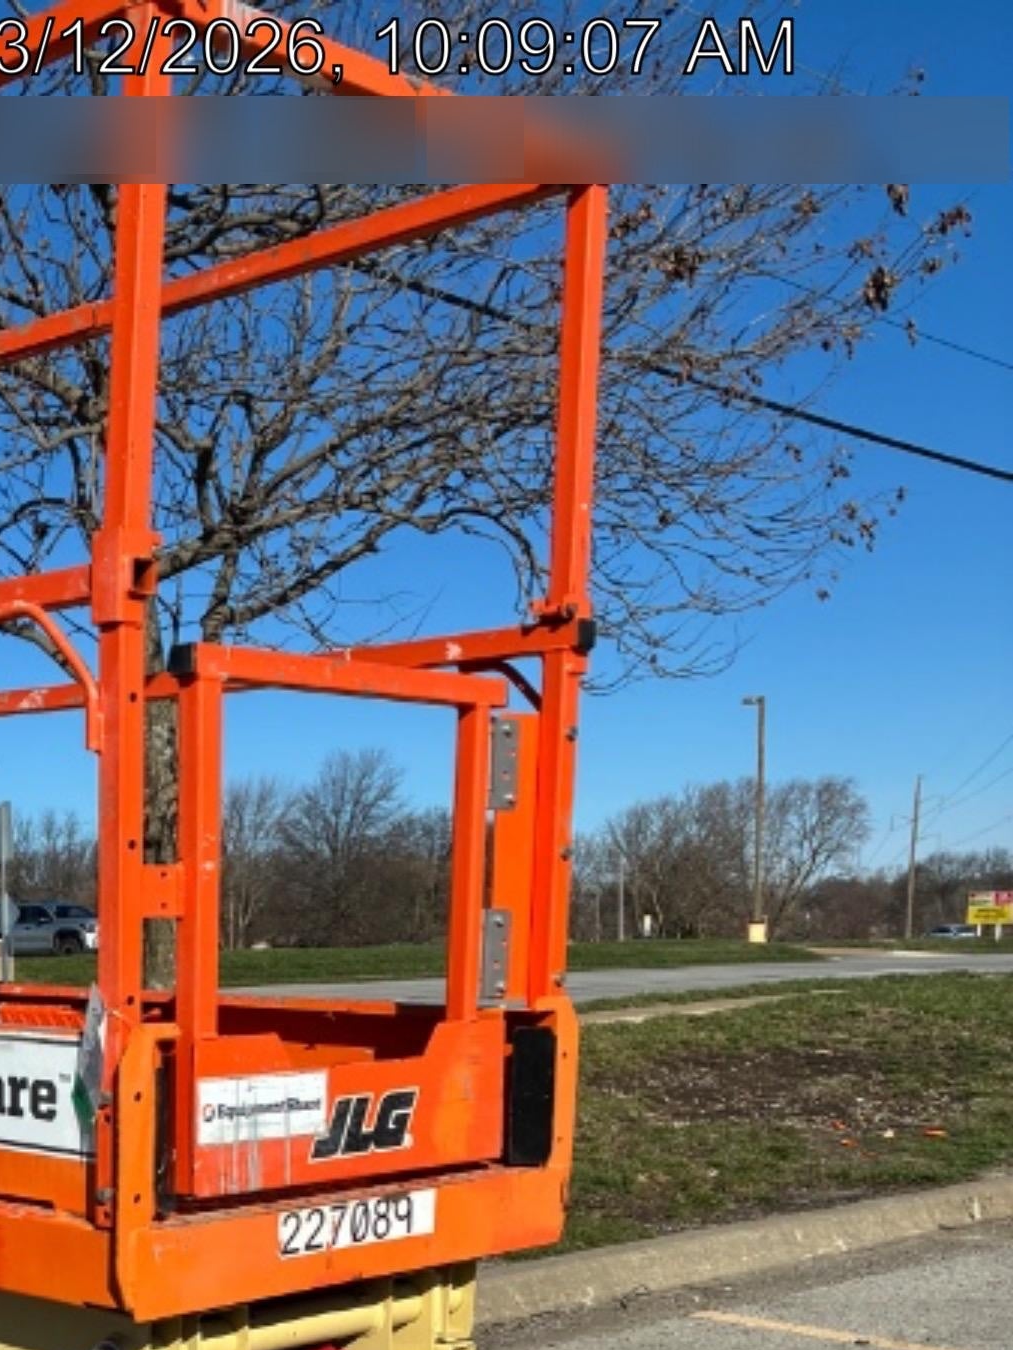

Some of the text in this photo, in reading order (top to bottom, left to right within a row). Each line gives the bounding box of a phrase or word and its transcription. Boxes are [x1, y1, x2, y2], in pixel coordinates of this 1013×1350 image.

[217, 1097, 322, 1121] EquipmentShare
[309, 1089, 418, 1160] JLG
[280, 1196, 414, 1255] 227089
